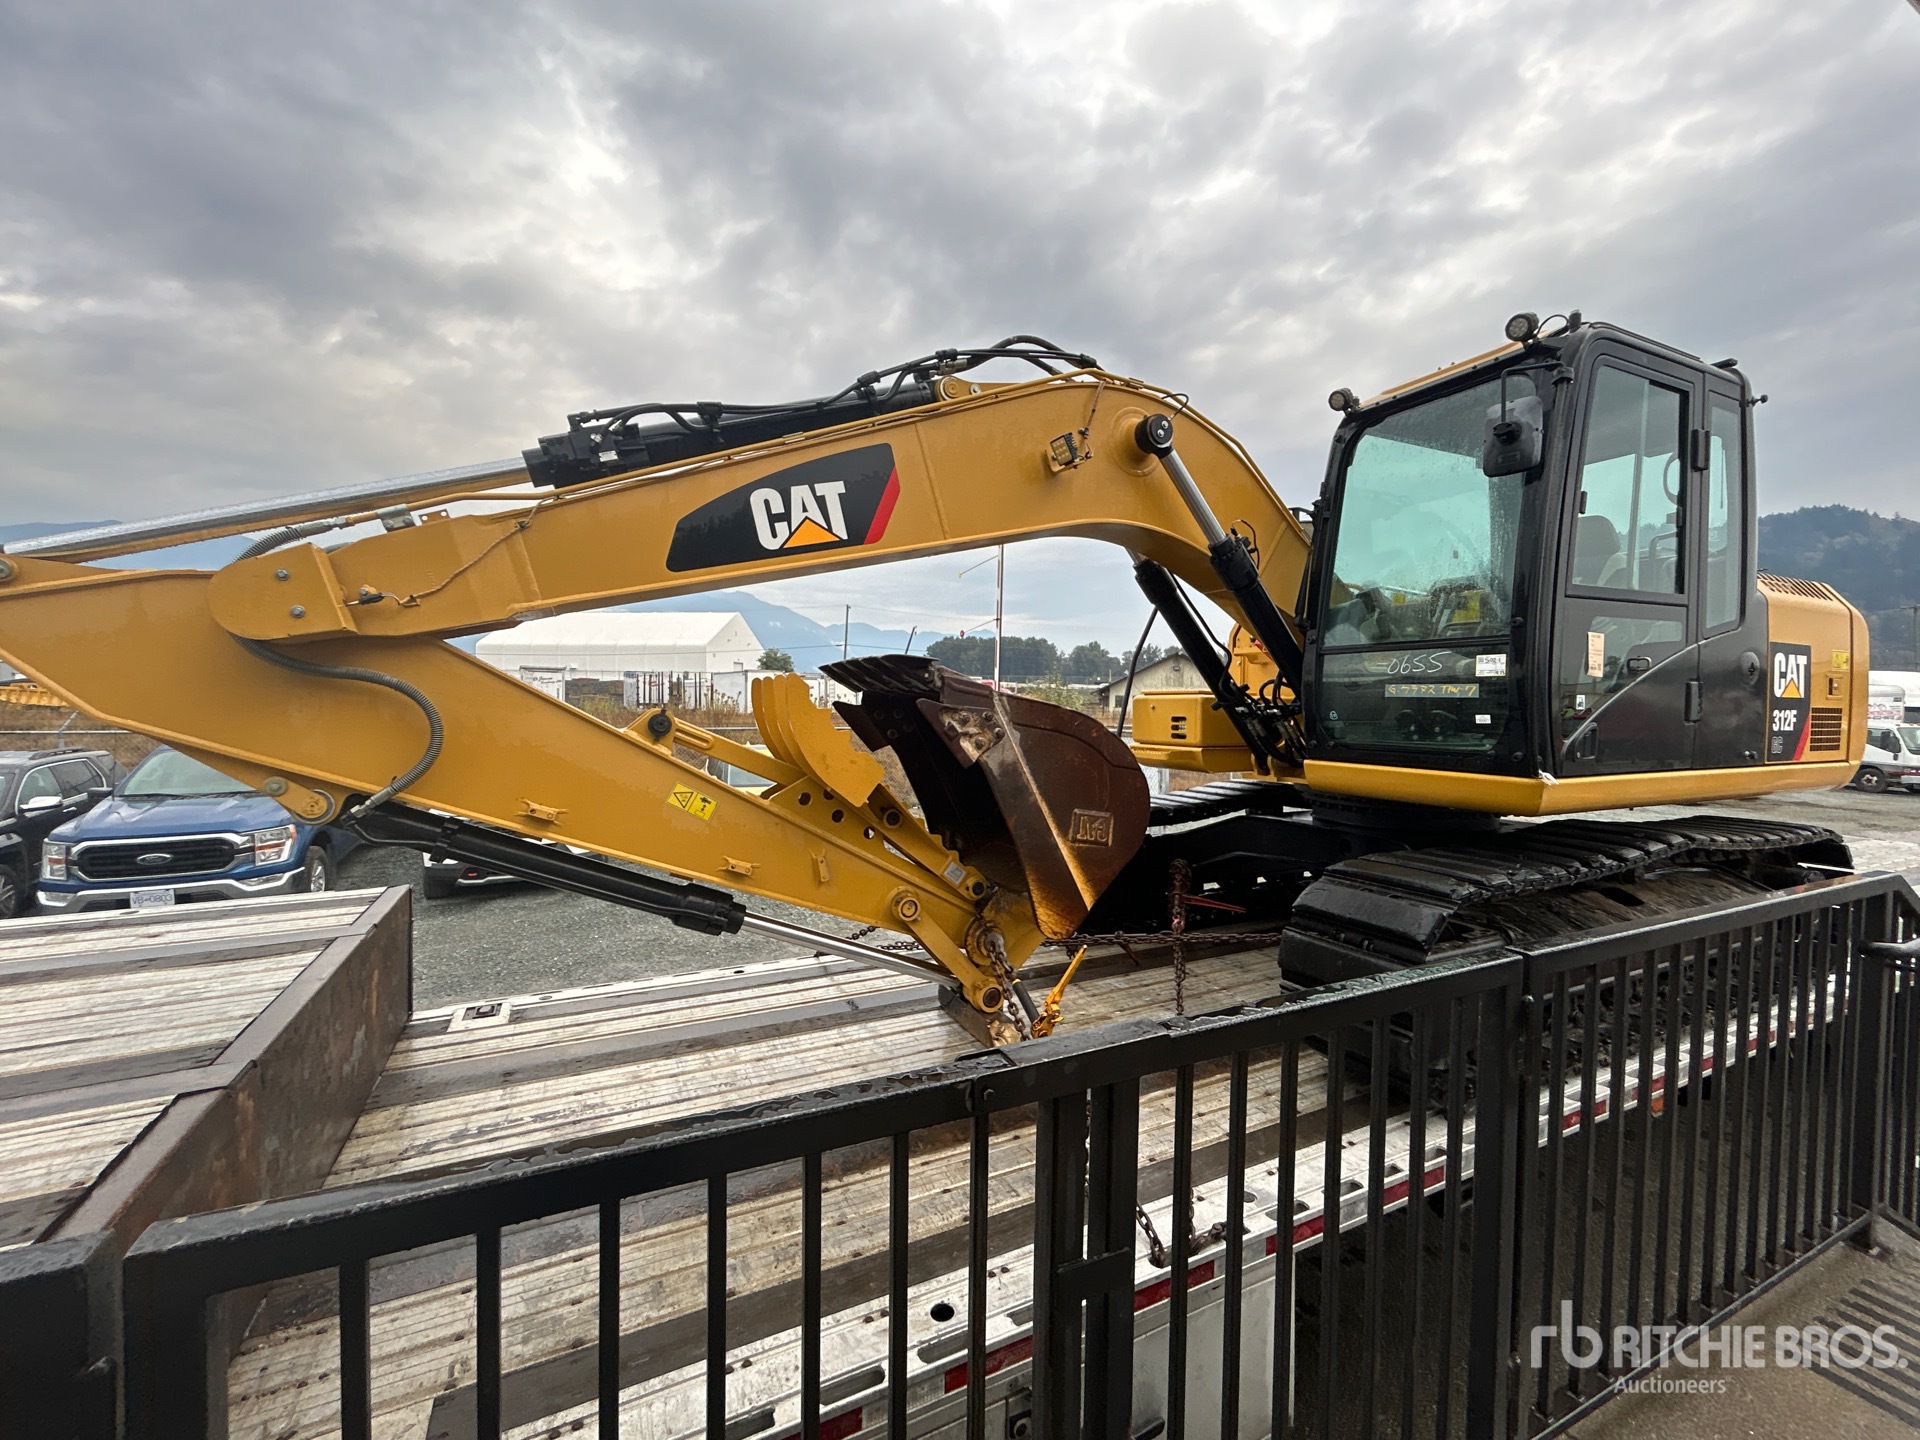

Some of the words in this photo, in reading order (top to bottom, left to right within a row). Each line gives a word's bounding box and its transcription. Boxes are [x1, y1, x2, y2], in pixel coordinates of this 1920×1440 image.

[749, 480, 849, 551] CAT
[1387, 650, 1452, 675] 0655
[1773, 652, 1808, 699] CAT
[1772, 709, 1798, 732] 312F
